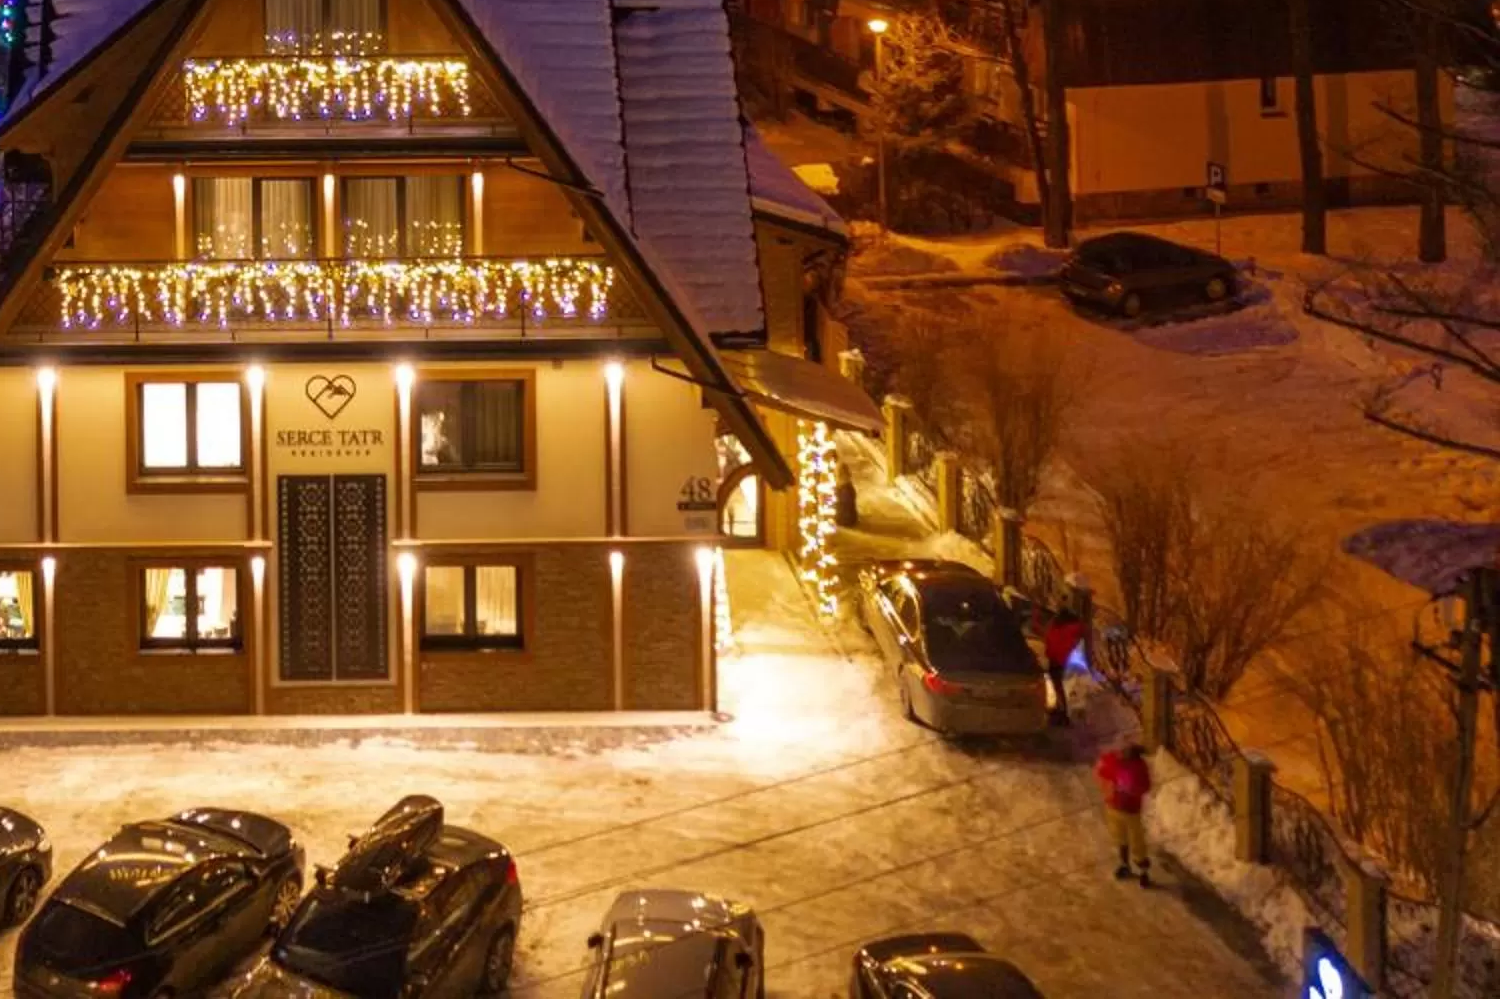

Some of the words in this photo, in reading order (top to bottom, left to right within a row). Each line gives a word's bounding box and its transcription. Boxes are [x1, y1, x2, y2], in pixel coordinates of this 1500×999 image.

[1211, 165, 1222, 185] P
[276, 430, 333, 446] SERCE
[337, 430, 384, 446] TATR
[679, 475, 711, 501] 48
